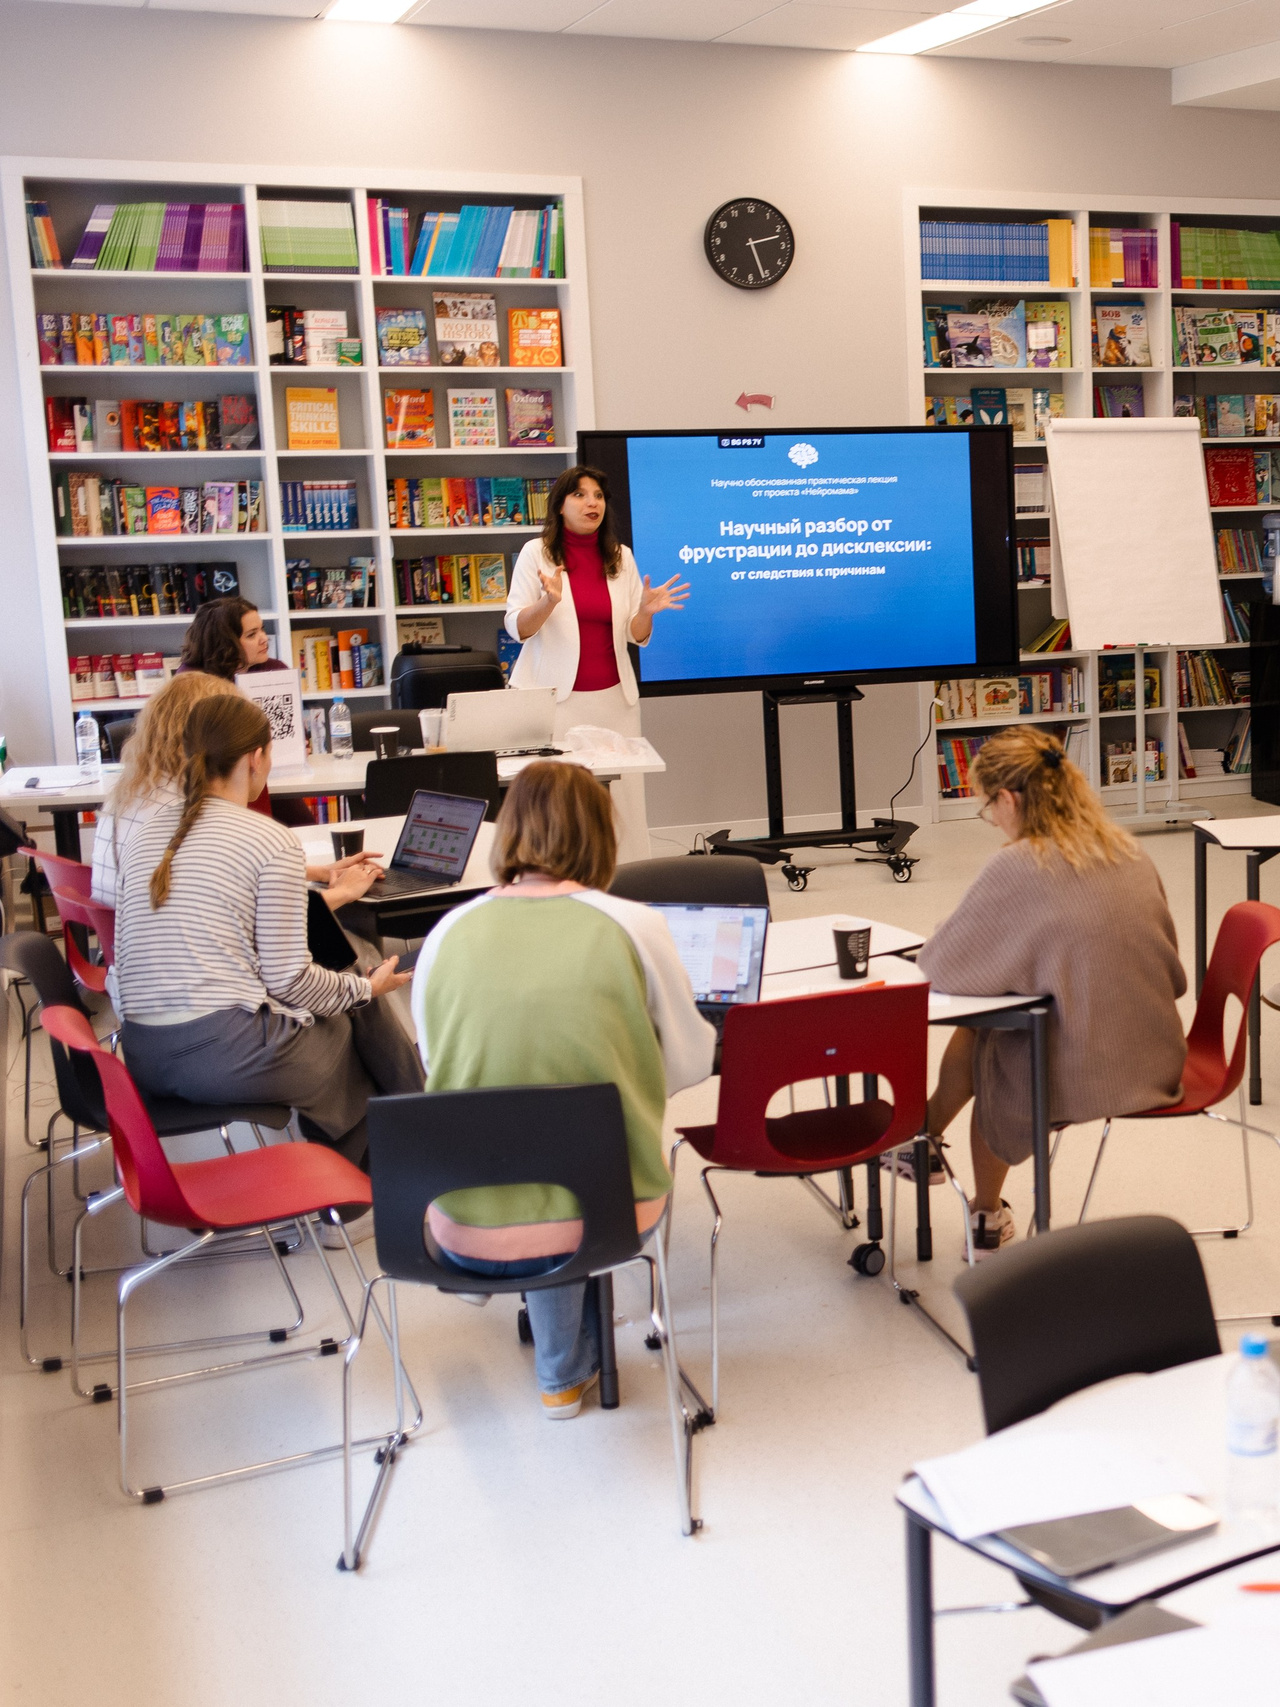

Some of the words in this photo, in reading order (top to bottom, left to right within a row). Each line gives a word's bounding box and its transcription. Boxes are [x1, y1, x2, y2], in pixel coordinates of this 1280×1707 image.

[719, 221, 727, 229] 10
[715, 237, 721, 245] 9
[732, 267, 737, 275] 7
[1101, 310, 1121, 318] BOB
[443, 323, 490, 331] WORLD
[443, 331, 492, 339] HISTORY
[513, 394, 544, 403] Oxford
[290, 402, 334, 411] CRITICAL
[291, 421, 337, 432] SKILLS
[711, 479, 743, 488] Научно
[745, 478, 807, 487] обоснованная
[808, 477, 866, 486] практическая
[867, 476, 898, 484] лекция
[764, 489, 799, 498] проекта
[801, 487, 859, 497] «Нейромама»
[720, 518, 801, 539] Научный
[805, 517, 868, 537] разбор
[871, 519, 892, 531] от
[678, 544, 792, 564] фрустрации
[795, 545, 818, 558] до
[821, 540, 932, 557] дисклексии:
[731, 570, 746, 580] от
[748, 568, 814, 580] следствия
[815, 568, 824, 577] к
[825, 566, 886, 578] причинам
